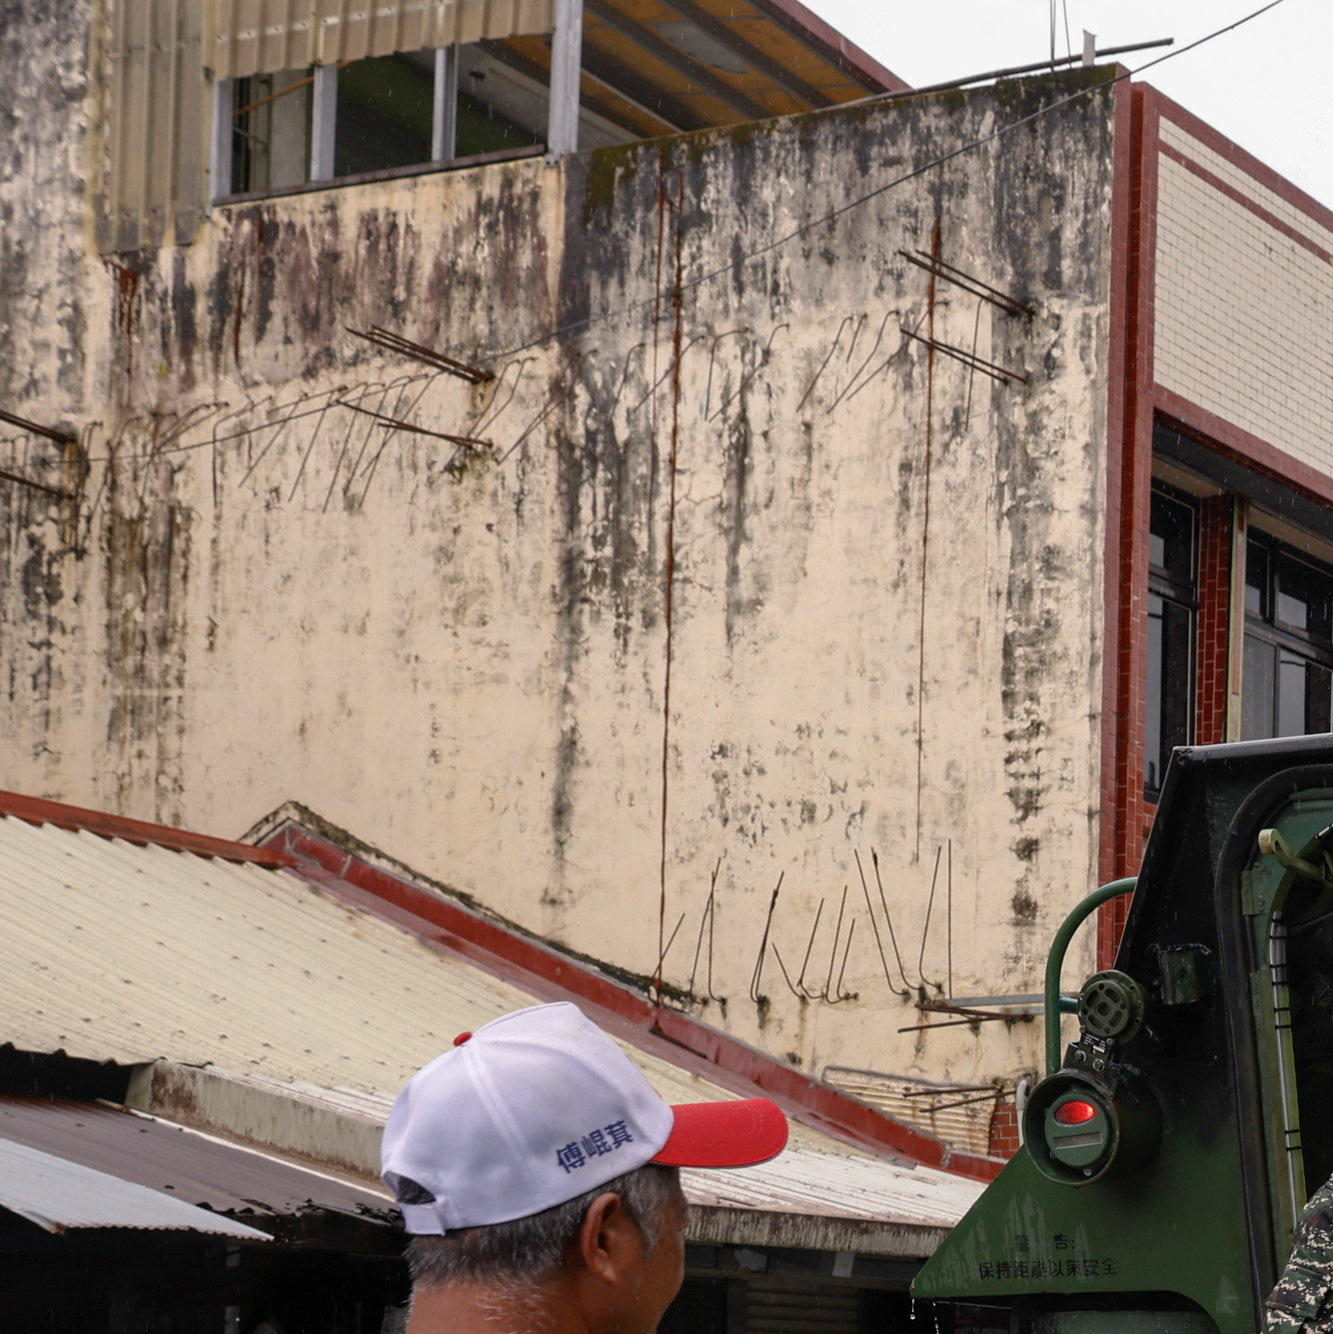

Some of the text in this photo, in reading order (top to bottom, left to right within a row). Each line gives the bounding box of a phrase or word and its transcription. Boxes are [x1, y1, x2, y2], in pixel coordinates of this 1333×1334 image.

[979, 1258, 1119, 1280] 保持距離以策安全
